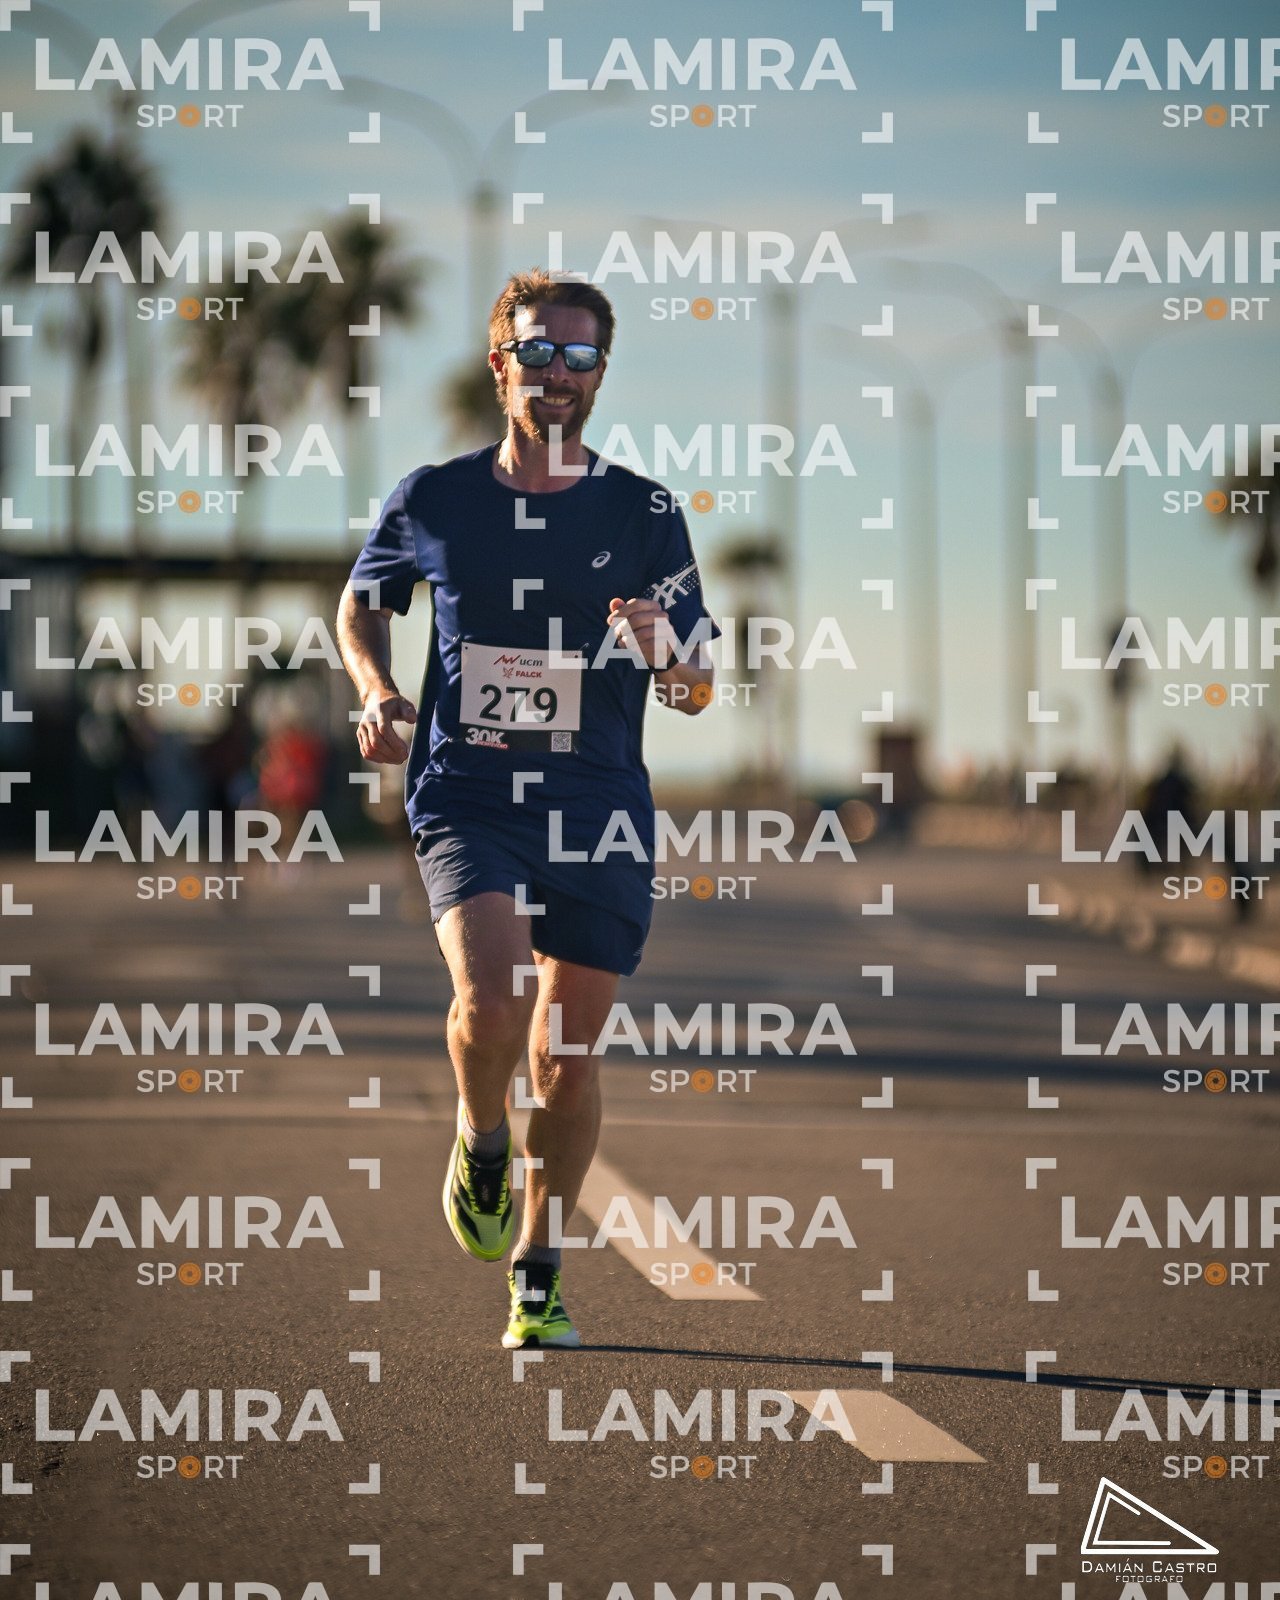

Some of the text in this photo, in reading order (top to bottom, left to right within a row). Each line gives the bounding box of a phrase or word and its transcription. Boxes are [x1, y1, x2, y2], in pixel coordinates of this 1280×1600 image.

[519, 658, 543, 667] ucm
[515, 670, 542, 679] FALCK
[478, 683, 558, 724] 279
[465, 727, 505, 745] 30K
